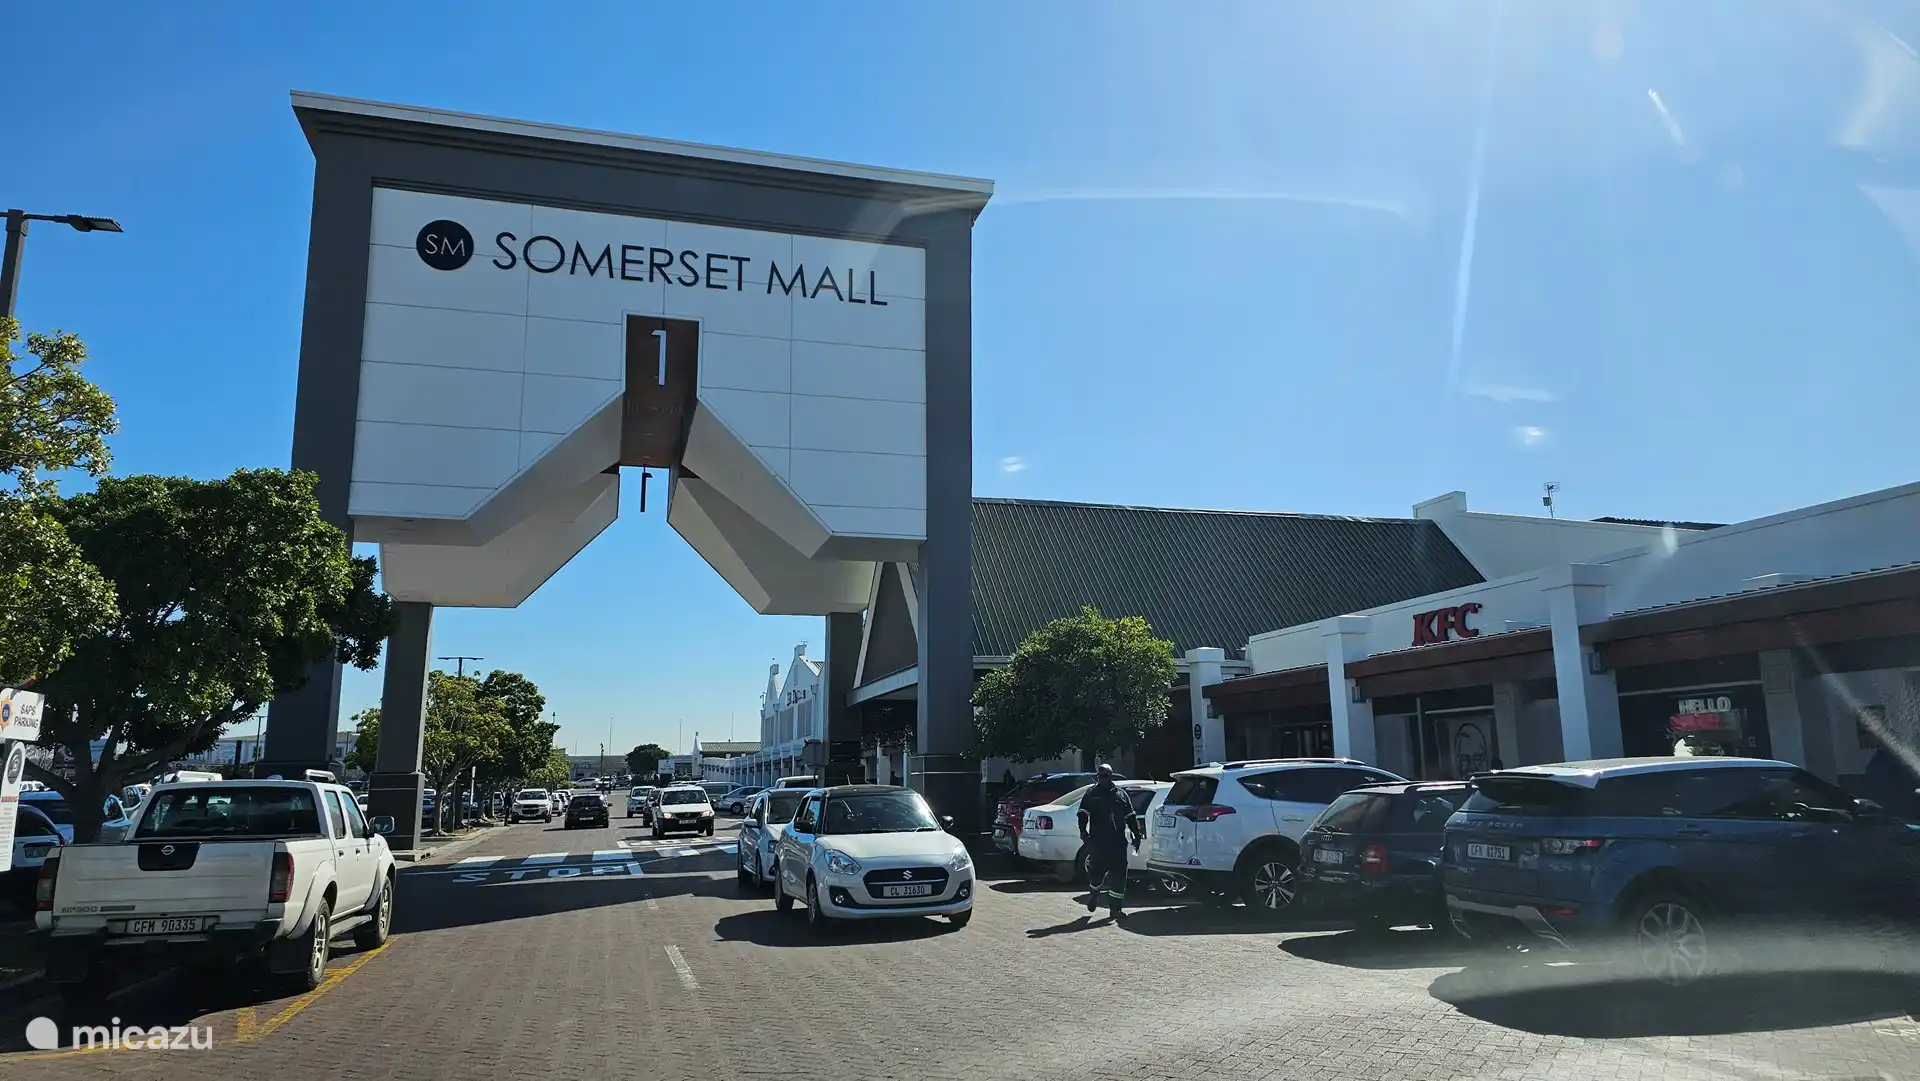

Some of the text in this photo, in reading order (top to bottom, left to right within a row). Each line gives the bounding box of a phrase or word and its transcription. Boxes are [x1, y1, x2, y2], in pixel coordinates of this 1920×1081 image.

[424, 233, 466, 258] SM
[492, 231, 888, 306] SOMERSET MALL
[651, 329, 667, 386] 1
[1411, 602, 1483, 647] KFC
[20, 704, 37, 716] SAPS
[1678, 697, 1732, 714] HELLO
[13, 715, 39, 728] PARKING
[452, 864, 626, 883] STOP
[890, 886, 900, 896] CL
[161, 918, 197, 932] 90335
